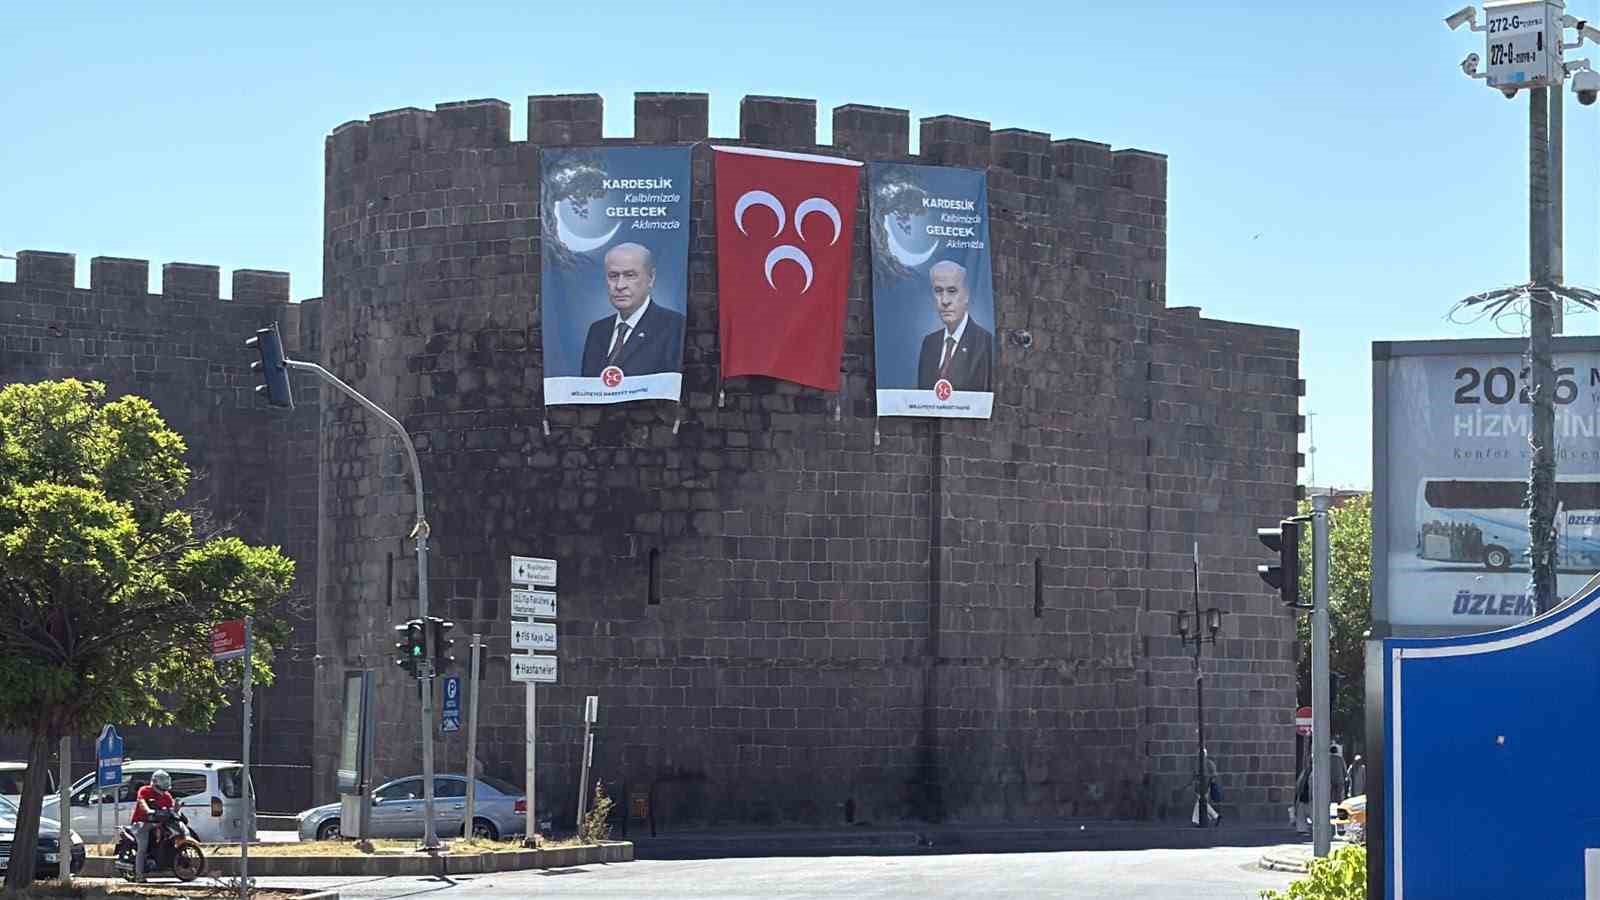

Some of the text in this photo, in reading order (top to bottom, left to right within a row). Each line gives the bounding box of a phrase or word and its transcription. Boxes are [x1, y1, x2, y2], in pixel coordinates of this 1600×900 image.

[624, 192, 681, 204] Kalbimizde
[606, 206, 667, 217] GELECEK
[926, 225, 975, 237] GELECEK
